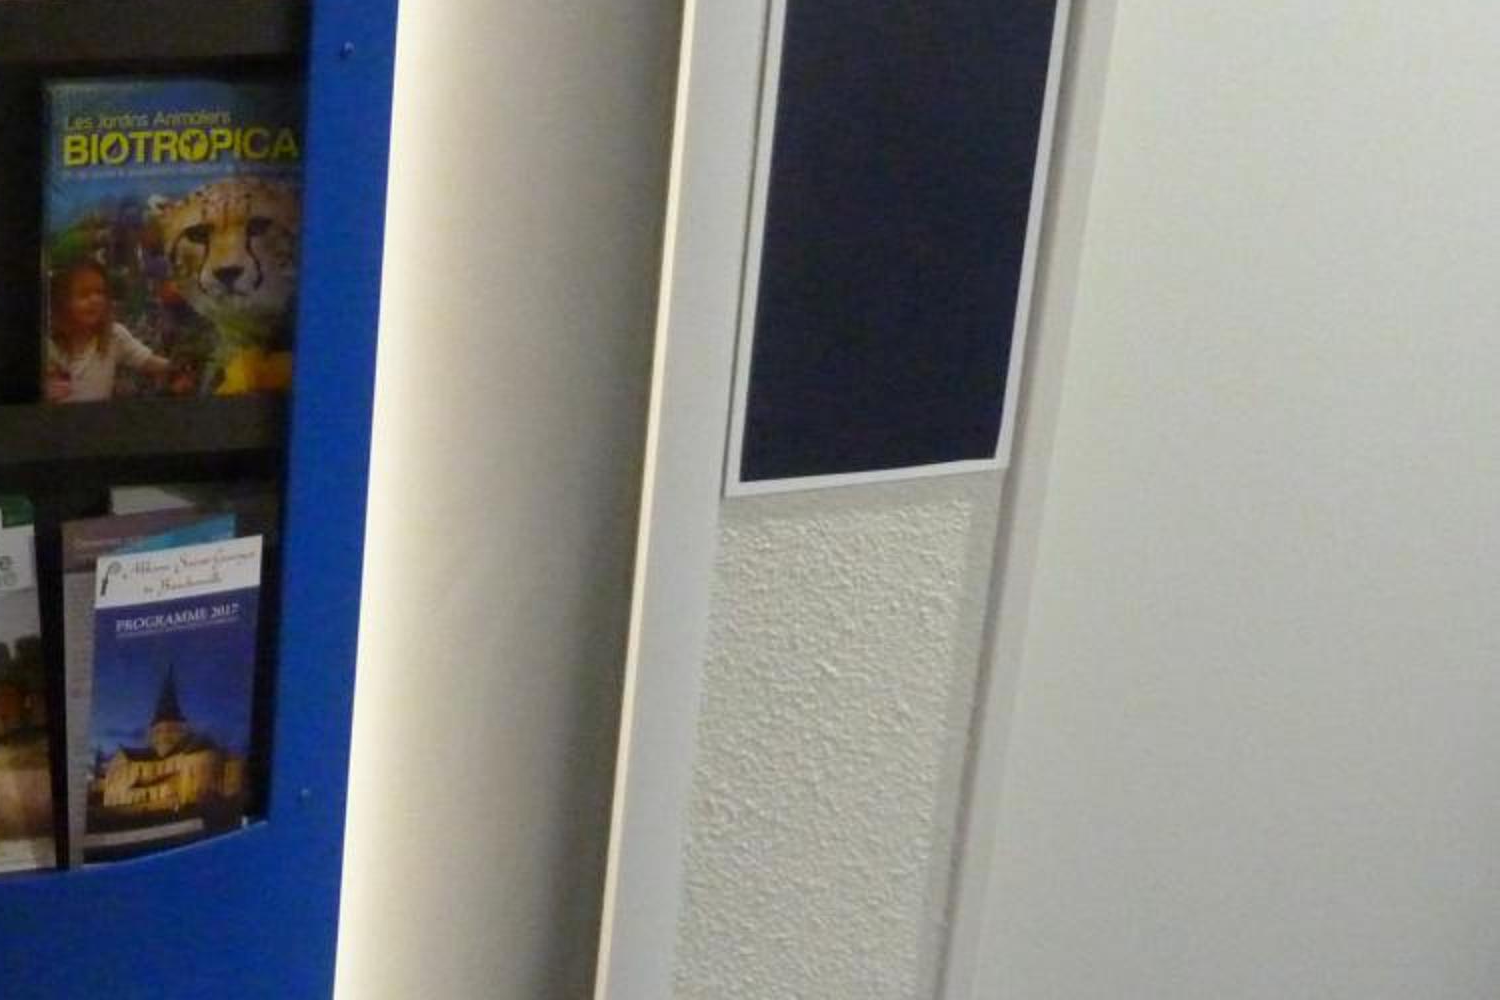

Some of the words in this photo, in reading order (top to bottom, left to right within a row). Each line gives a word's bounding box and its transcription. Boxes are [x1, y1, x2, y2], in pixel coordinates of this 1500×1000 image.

[62, 126, 299, 167] BIOTROPICA
[115, 607, 209, 633] PROGRAMME
[211, 602, 241, 620] 2017
